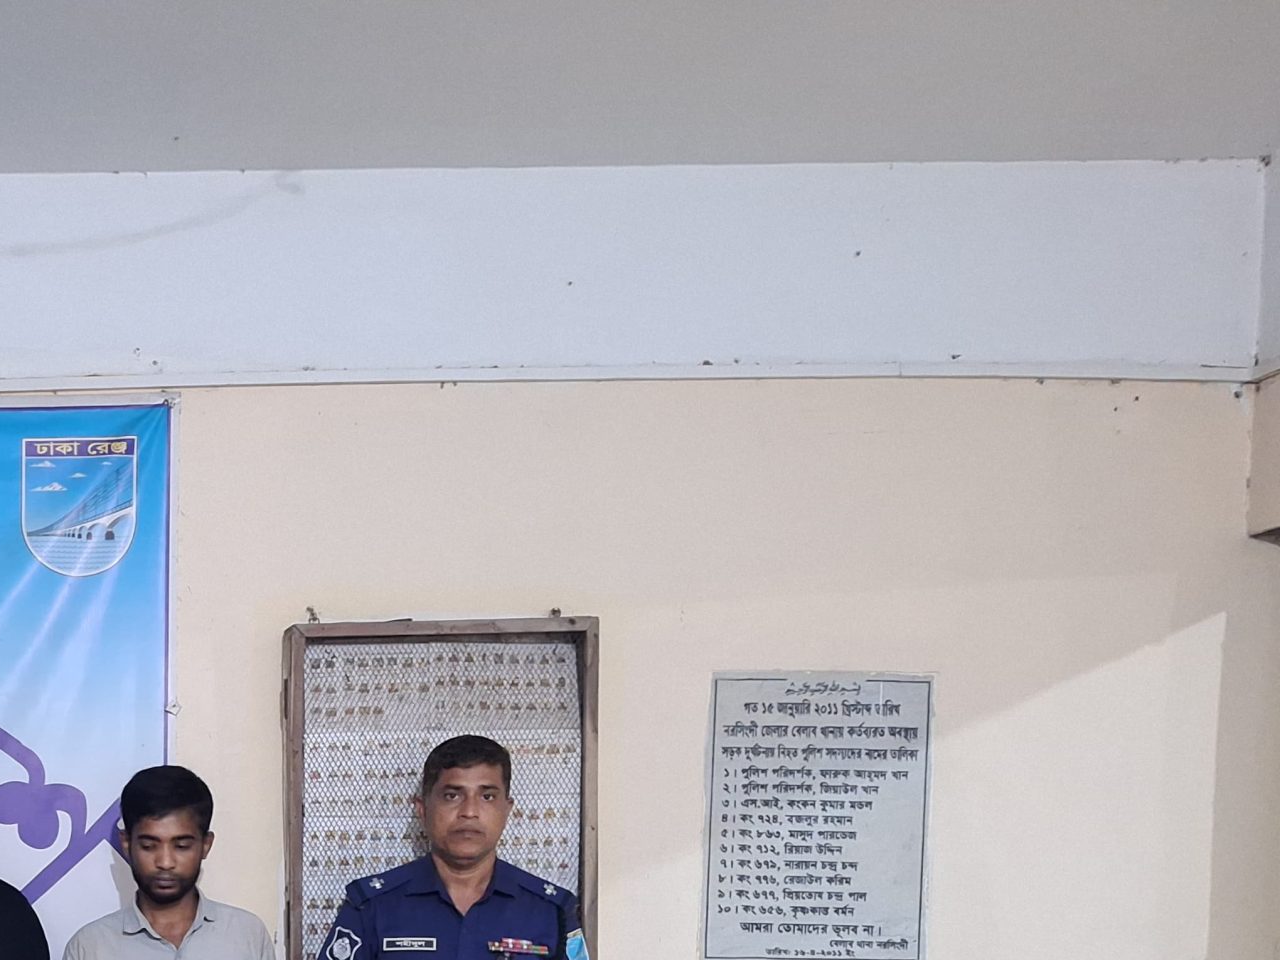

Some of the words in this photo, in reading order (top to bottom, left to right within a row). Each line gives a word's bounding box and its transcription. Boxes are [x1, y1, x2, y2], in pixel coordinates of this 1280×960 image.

[34, 441, 80, 456] ঢাকা
[88, 440, 128, 455] রেঞ্জ
[744, 703, 758, 714] গত
[815, 703, 837, 715] ২০১১
[762, 726, 788, 737] জেলার
[792, 726, 817, 738] বেলাব
[722, 747, 741, 760] সড়ক
[778, 745, 798, 759] নিহত
[801, 745, 822, 761] পুলিশ
[741, 766, 768, 780] পুলিশ
[892, 771, 908, 780] খান
[741, 781, 768, 795] পুলিশ
[862, 785, 879, 795] খান
[741, 815, 754, 824] কং
[822, 816, 853, 825] রহমান
[740, 831, 753, 839] কং
[739, 845, 751, 854] কং
[738, 860, 751, 869] কং
[738, 875, 751, 884] কং
[826, 874, 851, 886] করিম
[736, 890, 749, 899] কং
[848, 892, 867, 901] পাল
[742, 905, 756, 914] কং
[834, 905, 854, 917] বর্মন
[740, 923, 773, 934] আমরা
[778, 923, 828, 934] তোমাদের
